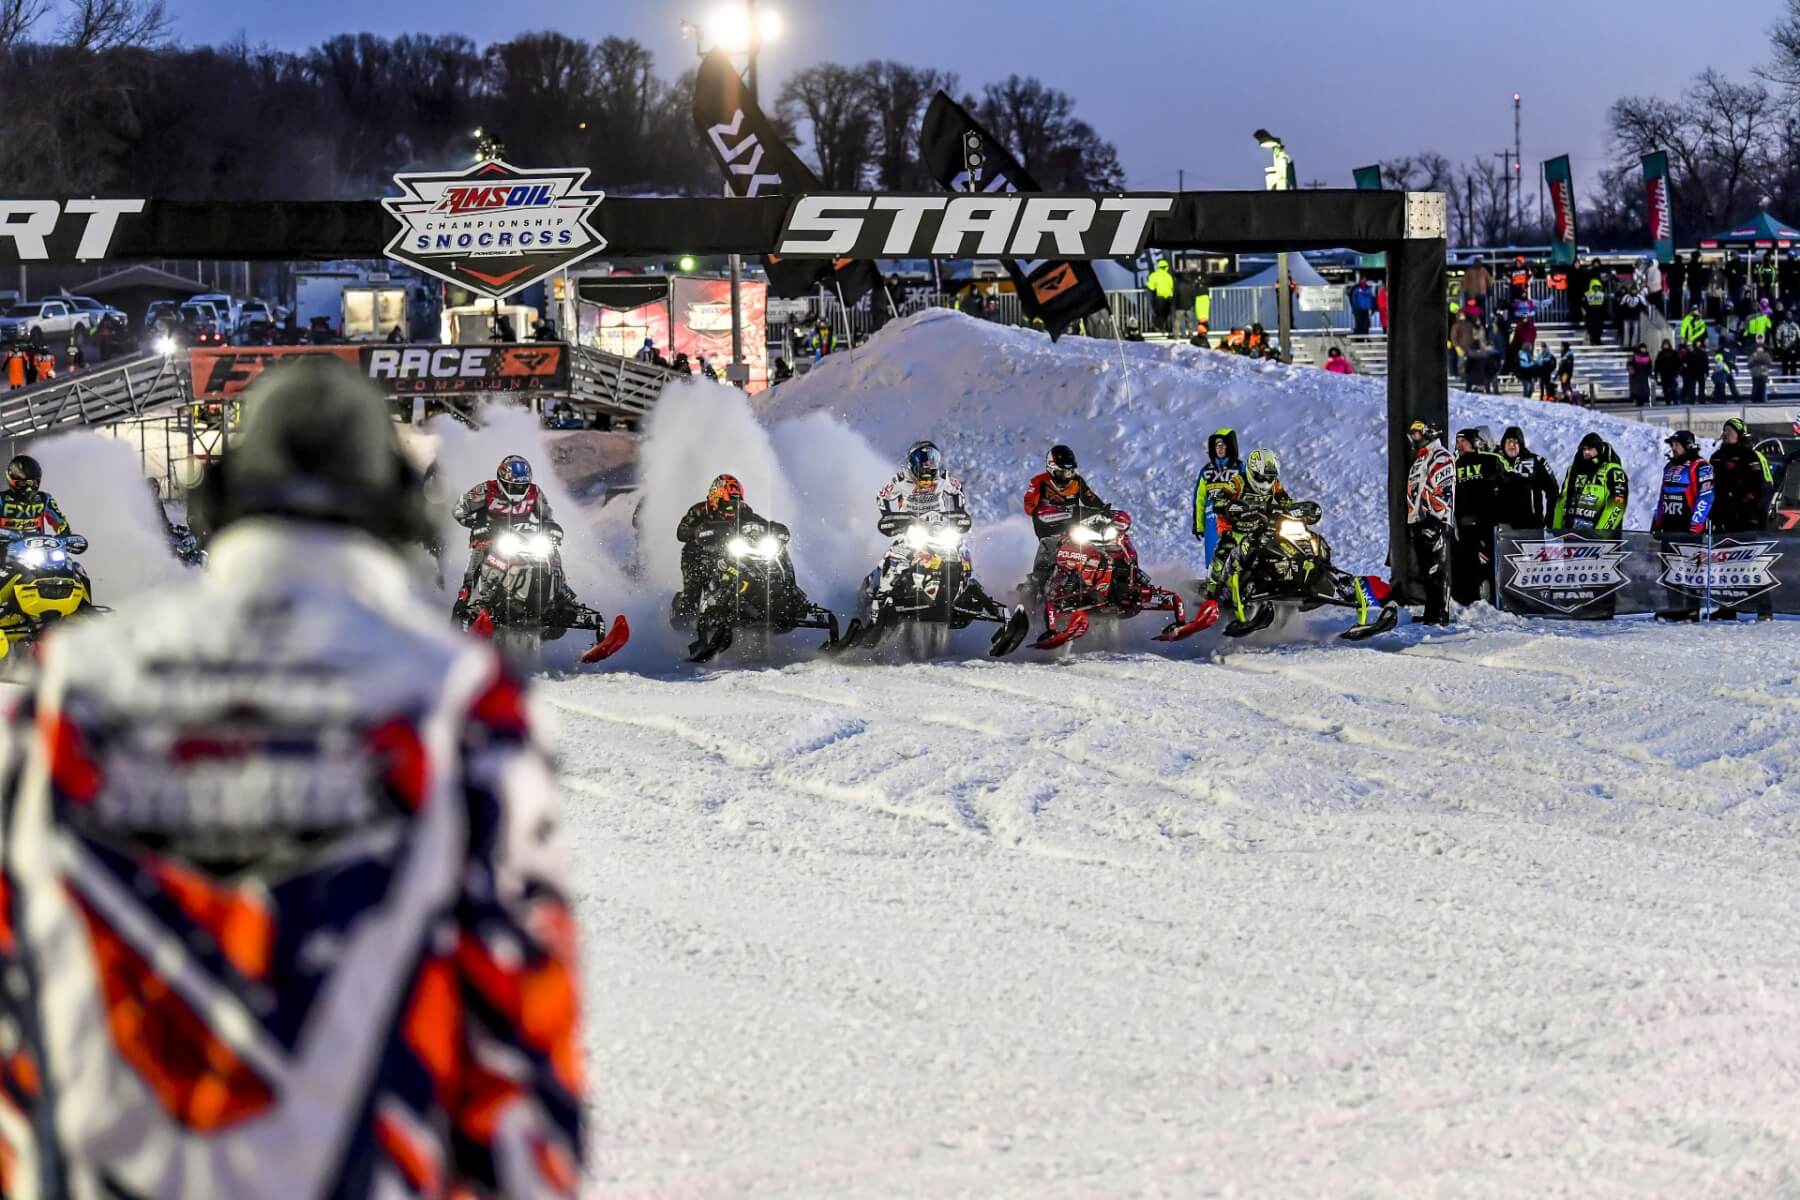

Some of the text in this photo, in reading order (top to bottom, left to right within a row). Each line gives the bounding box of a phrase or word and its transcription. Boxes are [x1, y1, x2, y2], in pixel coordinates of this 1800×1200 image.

[437, 185, 552, 214] AMSOIL
[426, 218, 563, 230] CHAMPIONSHIP
[779, 196, 1174, 255] START
[417, 230, 571, 249] SNOCROSS
[368, 348, 491, 378] RACE
[395, 378, 540, 391] COMPOUND
[1435, 466, 1451, 482] FXR
[1458, 464, 1482, 478] FLY
[1691, 500, 1708, 523] FXR
[1058, 551, 1087, 561] POLARIS
[1535, 546, 1601, 562] AMSOIL
[1521, 572, 1610, 585] SNOCROSS
[1675, 573, 1761, 585] SNOCROSS
[1552, 591, 1594, 600] RAM
